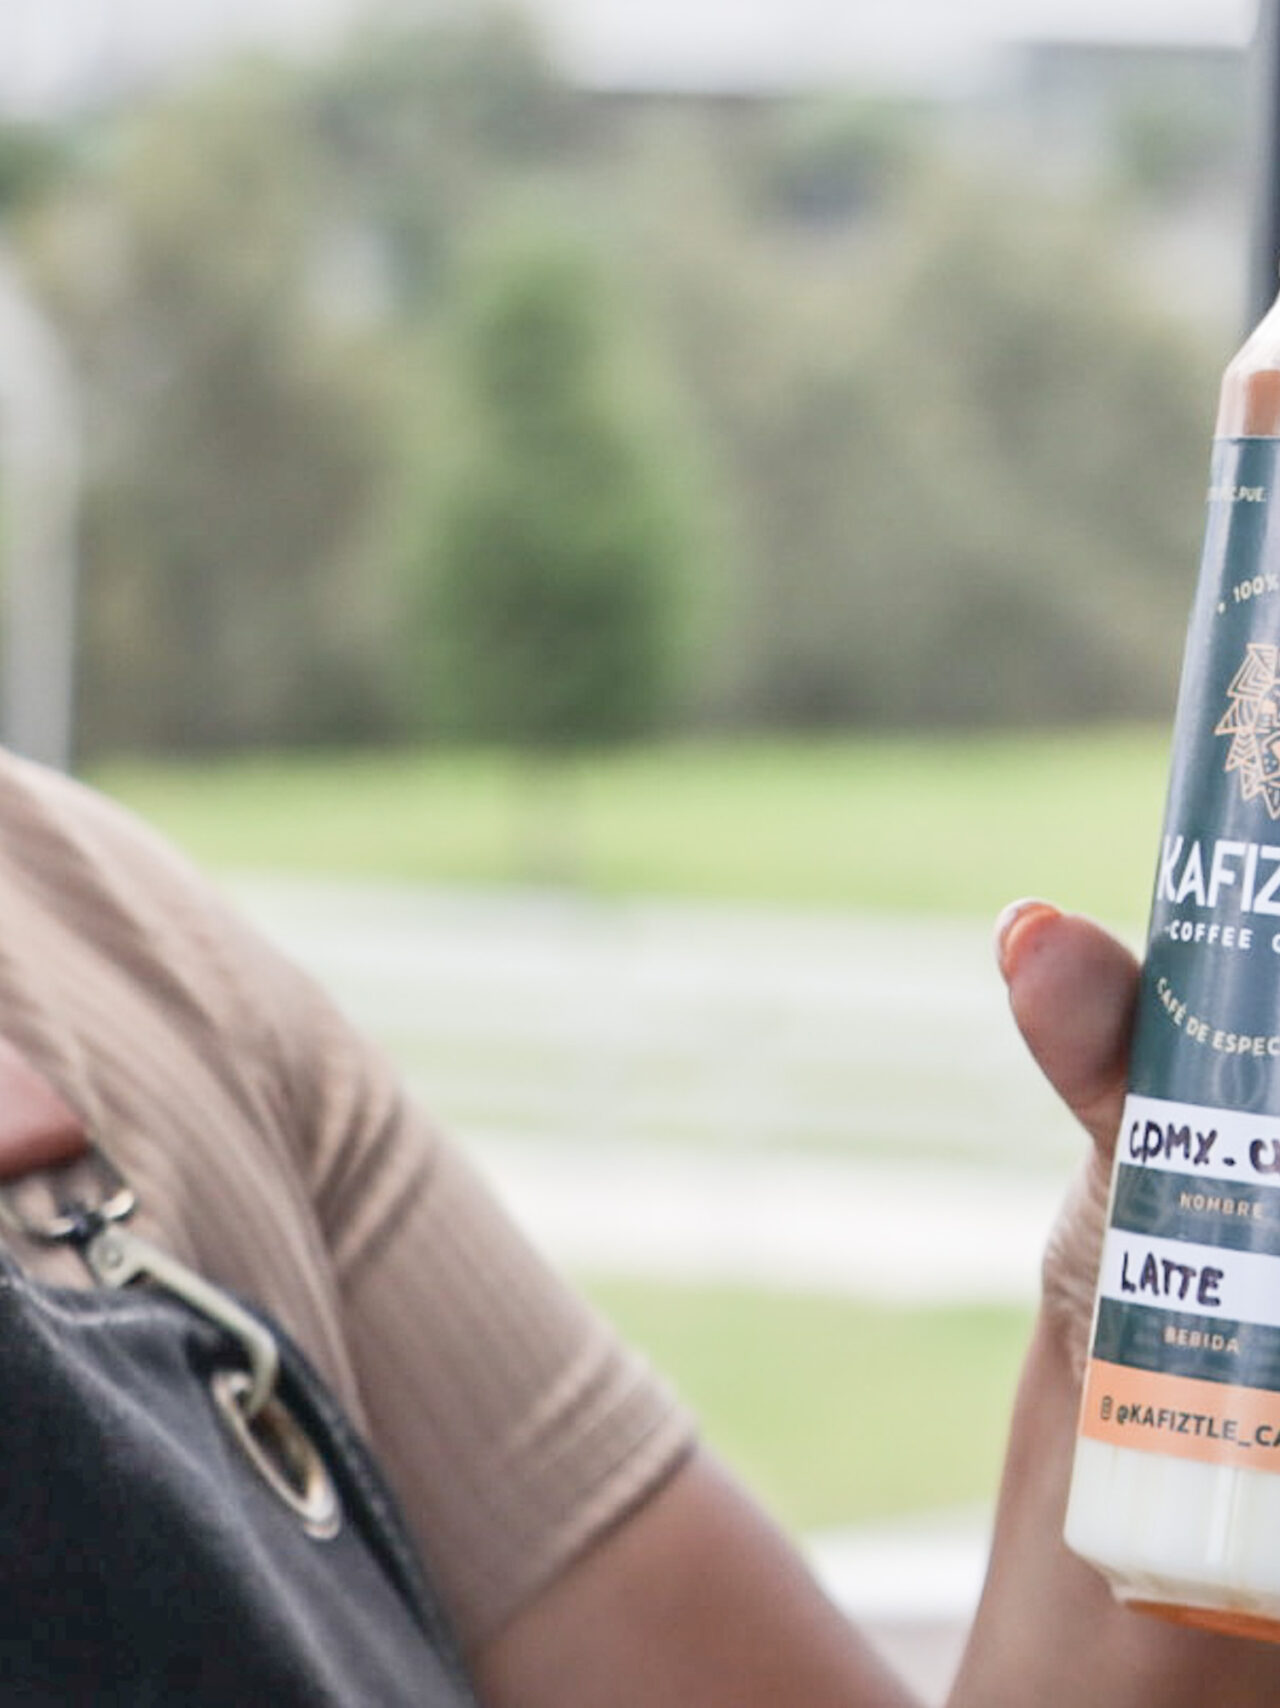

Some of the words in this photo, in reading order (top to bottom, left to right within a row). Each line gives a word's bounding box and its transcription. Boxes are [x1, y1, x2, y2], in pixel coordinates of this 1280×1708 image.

[1233, 573, 1278, 603] 100%
[1157, 977, 1187, 1026] CAFÉ
[1185, 1016, 1210, 1043] DE
[1180, 1193, 1263, 1219] NOMBRE
[1121, 1251, 1223, 1306] LATTE
[1164, 1326, 1240, 1354] BEBIDA
